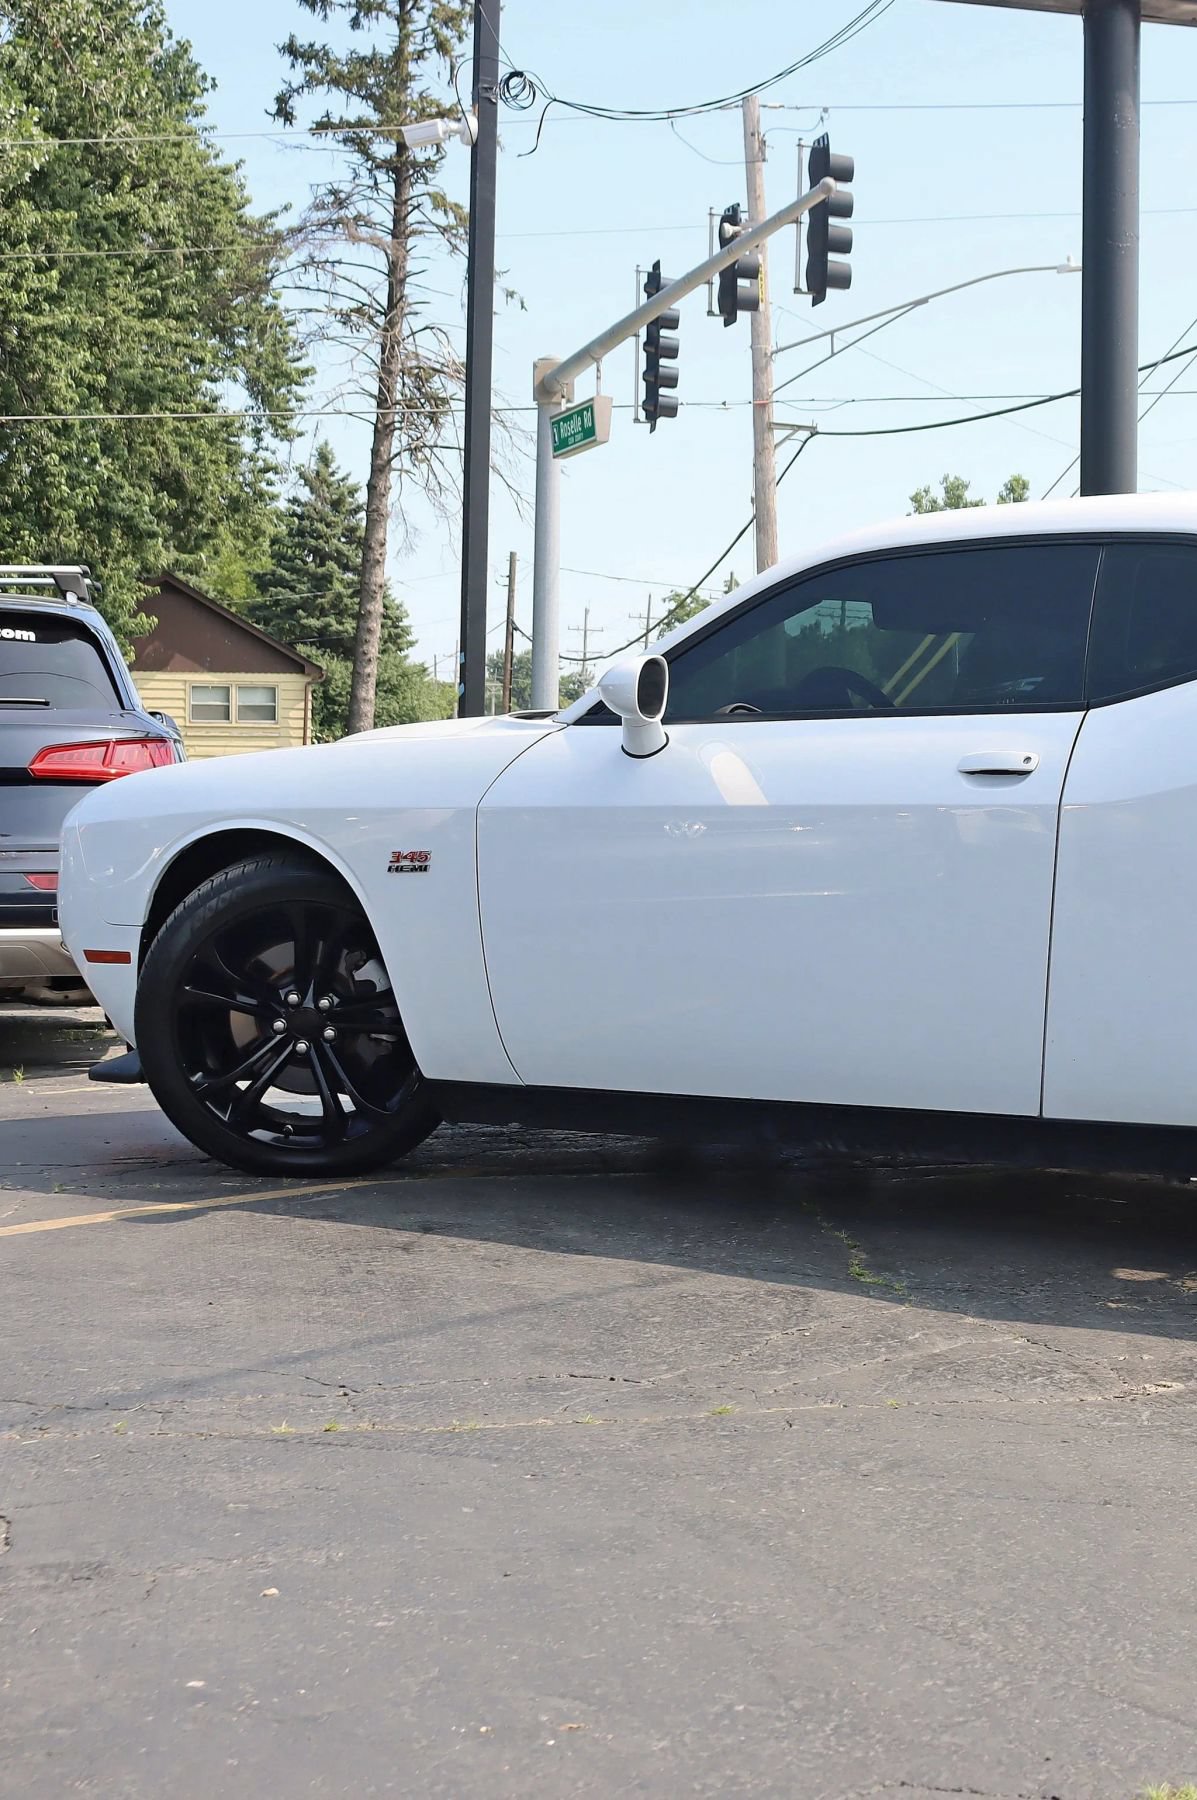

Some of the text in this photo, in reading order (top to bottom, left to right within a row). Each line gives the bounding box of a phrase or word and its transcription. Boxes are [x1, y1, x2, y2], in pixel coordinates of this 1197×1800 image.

[560, 413, 582, 439] Roselle
[583, 407, 592, 429] Rd
[389, 850, 431, 863] 345
[387, 864, 430, 873] HEMI
